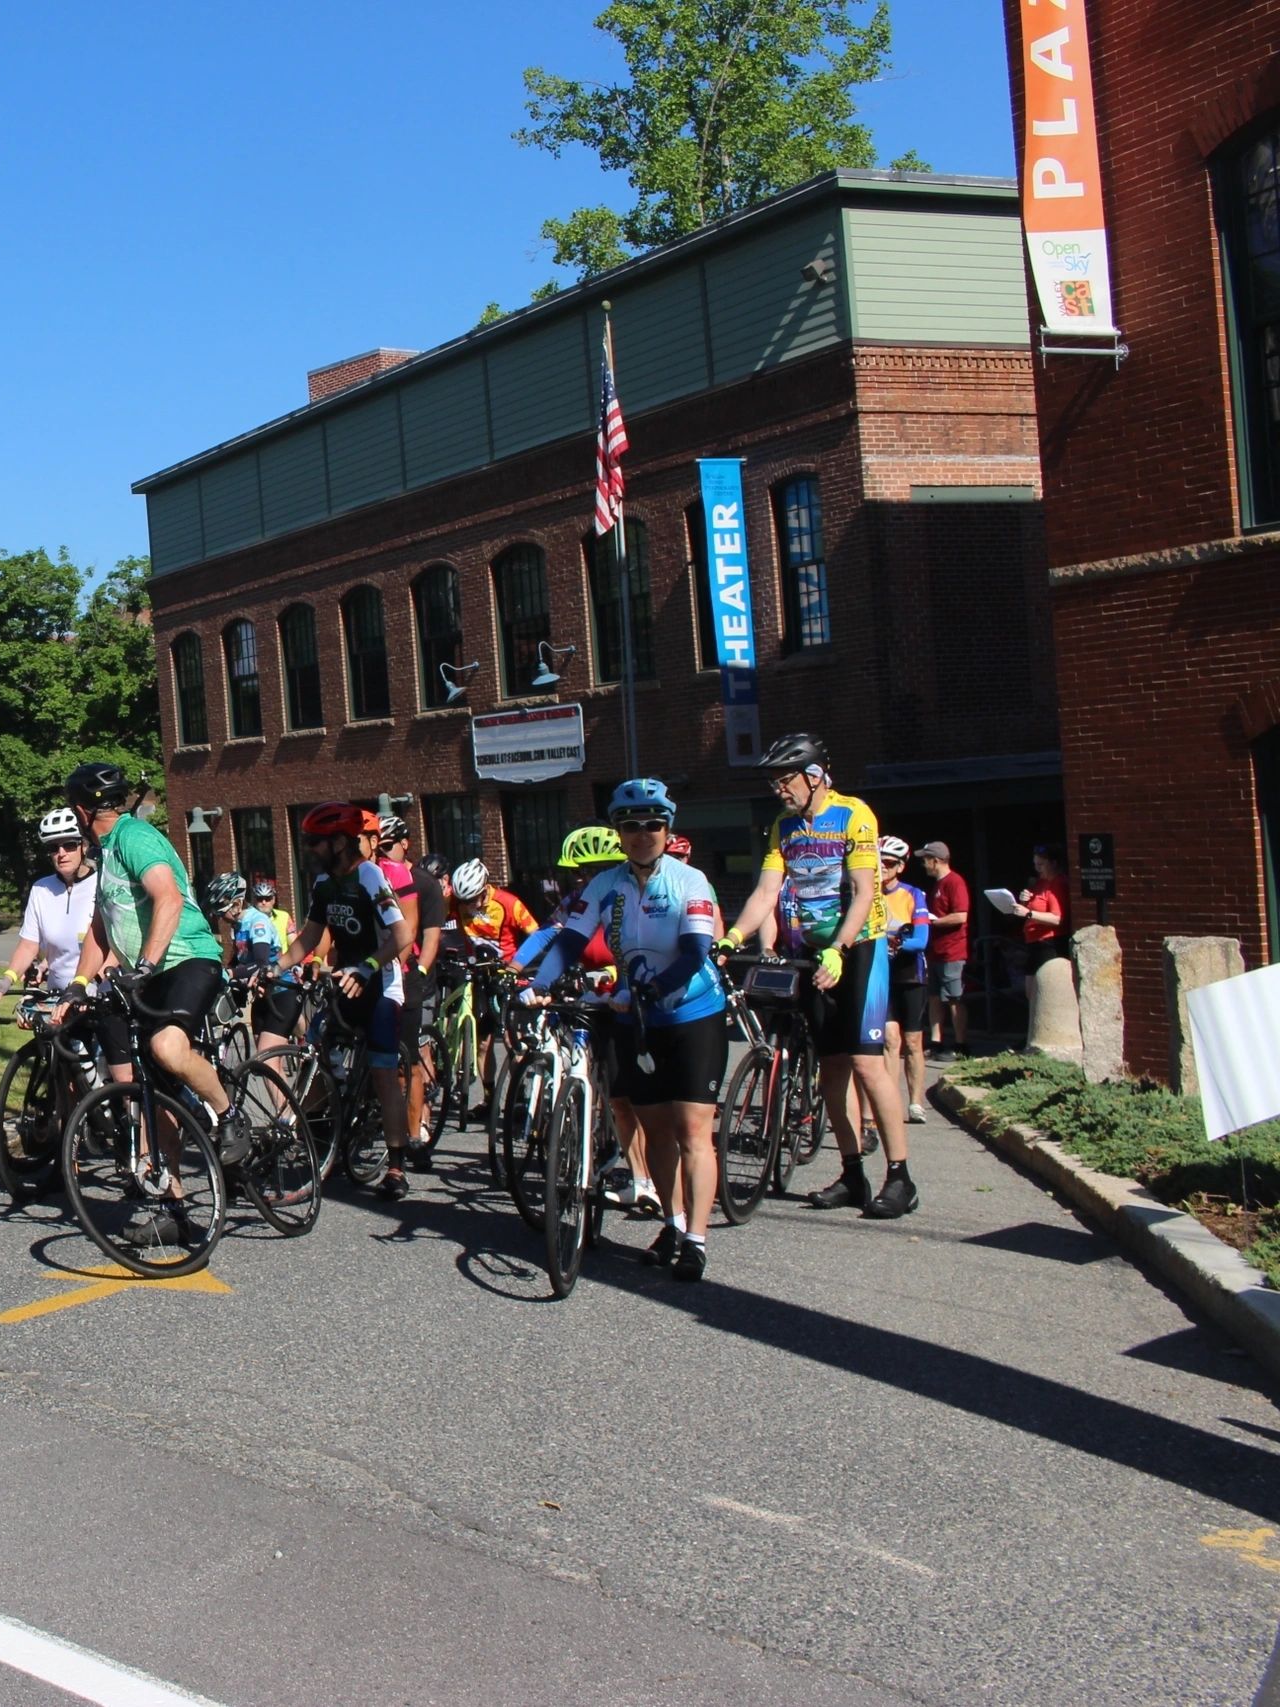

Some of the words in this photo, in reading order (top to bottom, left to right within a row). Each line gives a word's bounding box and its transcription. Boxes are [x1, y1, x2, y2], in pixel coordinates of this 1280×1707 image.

[1029, 0, 1084, 199] PLA
[1042, 241, 1080, 259] Open
[1064, 255, 1089, 275] Sky
[1053, 280, 1067, 317] VALLEY
[712, 502, 753, 698] THEATER
